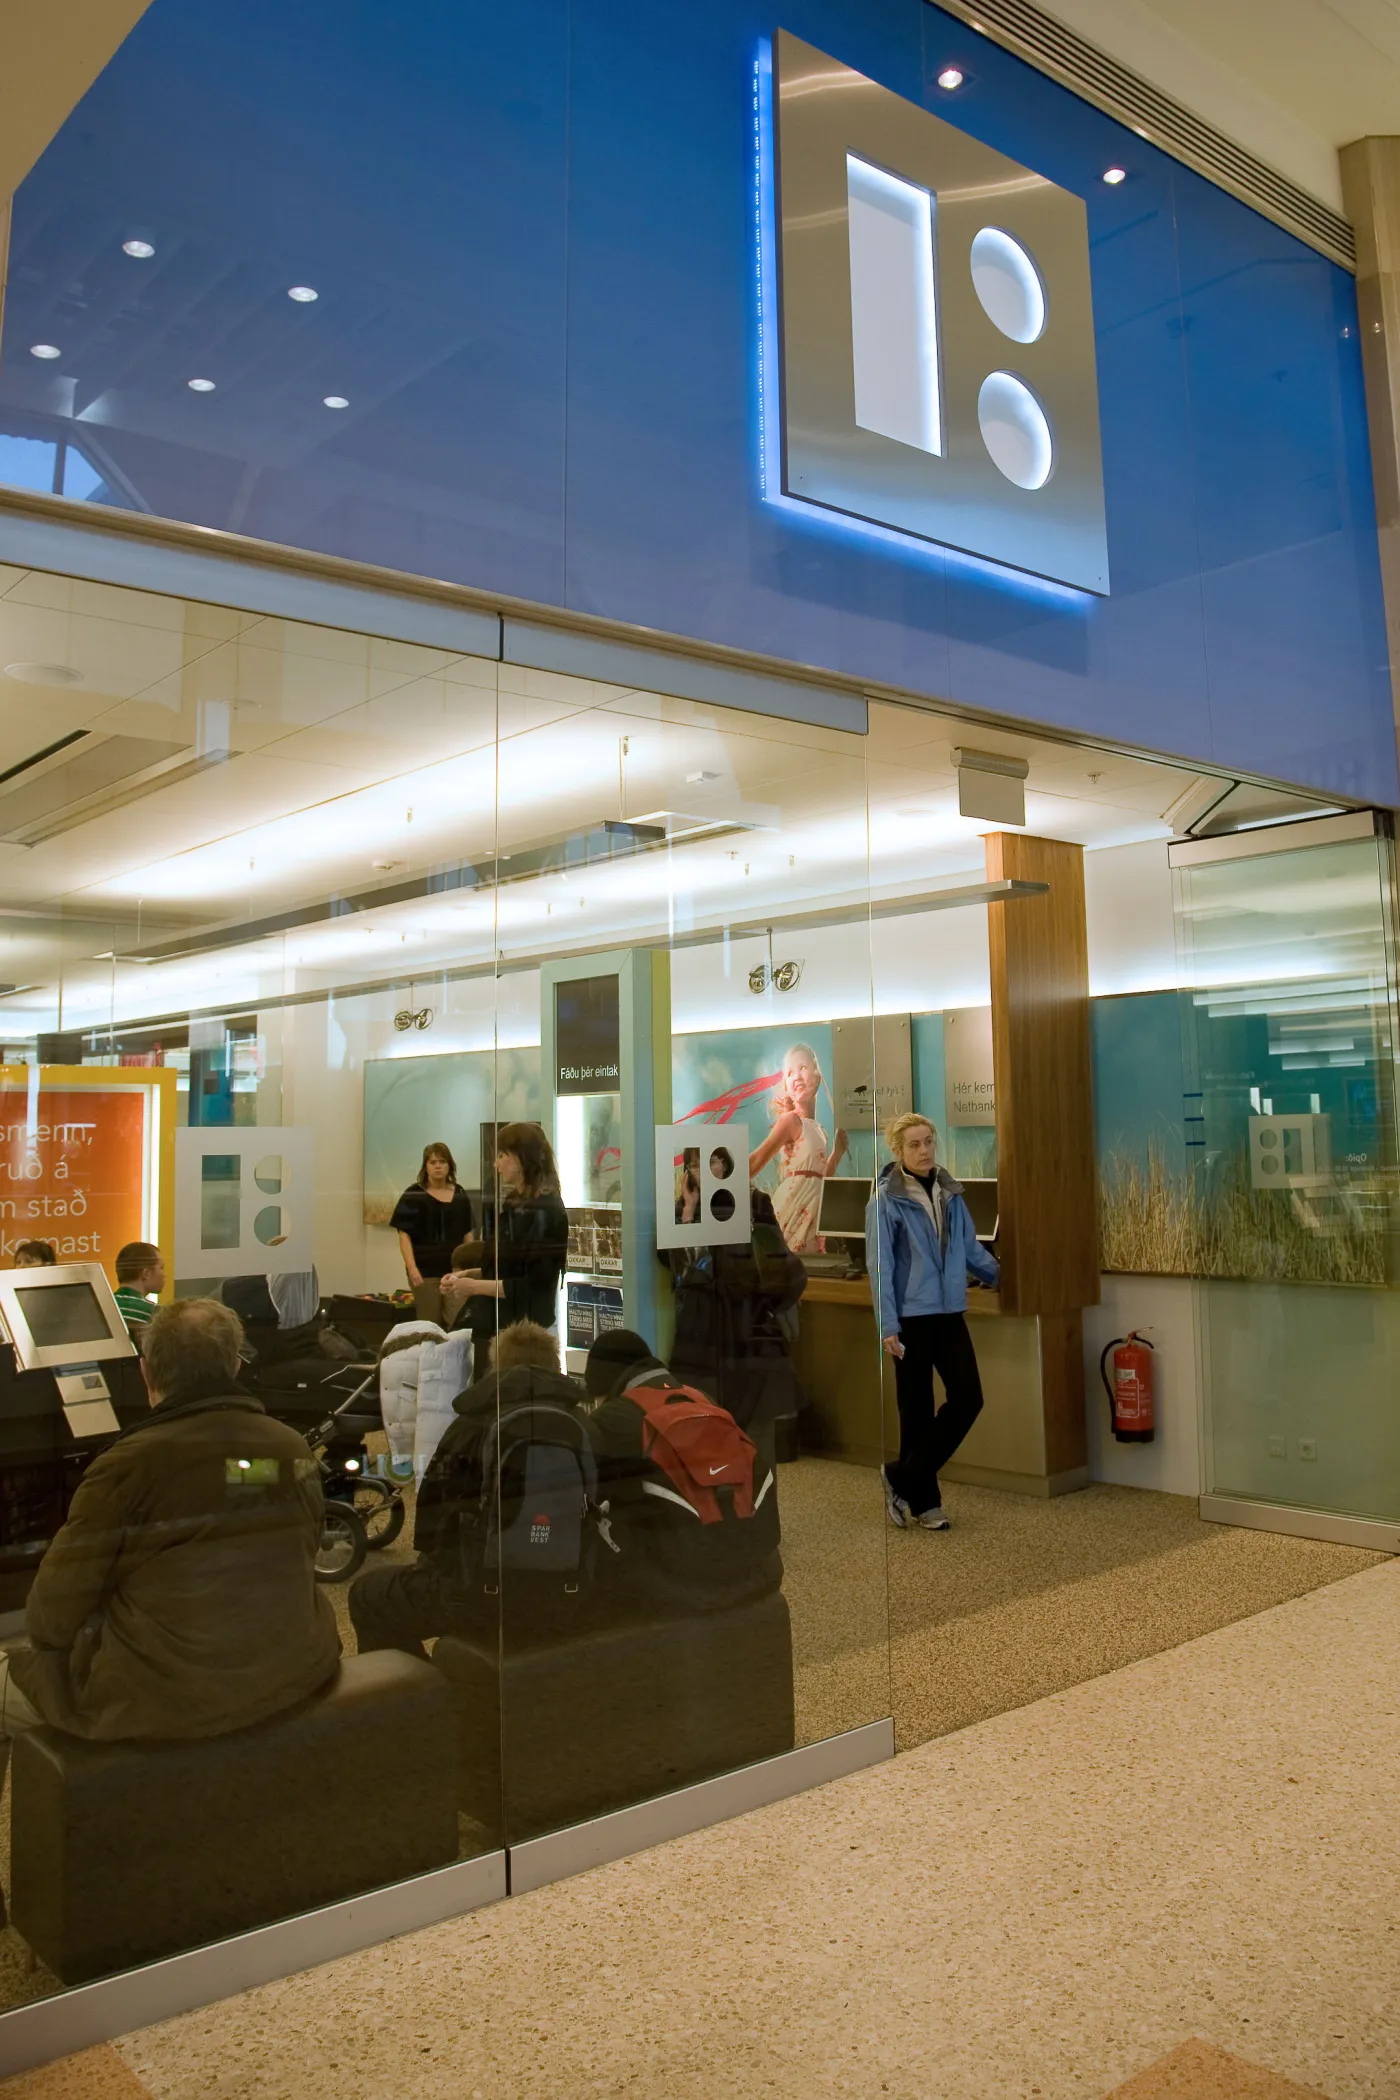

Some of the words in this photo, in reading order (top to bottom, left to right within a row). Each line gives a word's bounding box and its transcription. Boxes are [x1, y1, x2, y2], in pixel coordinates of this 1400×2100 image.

[560, 1066, 580, 1079] Fáðu
[581, 1066, 594, 1081] þér
[595, 1064, 618, 1077] eintak
[953, 1082, 972, 1094] Hér
[54, 1154, 69, 1179] á
[28, 1188, 87, 1218] stað
